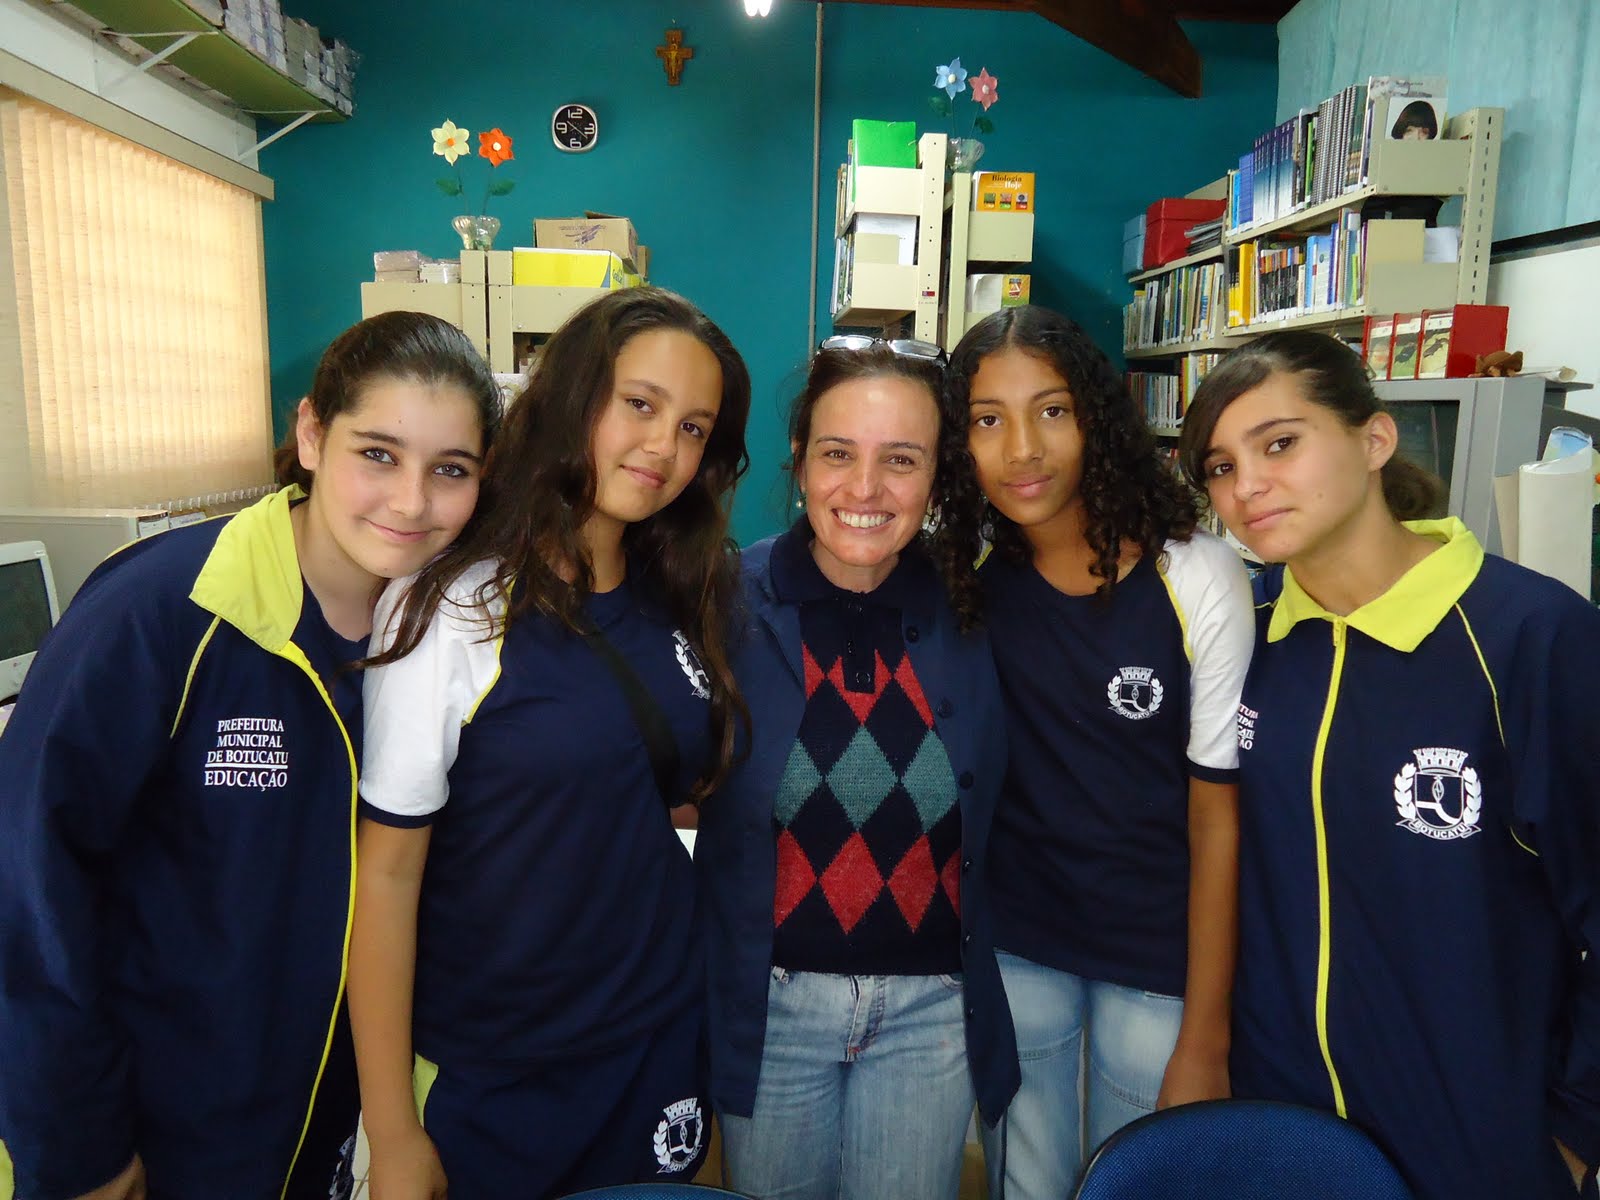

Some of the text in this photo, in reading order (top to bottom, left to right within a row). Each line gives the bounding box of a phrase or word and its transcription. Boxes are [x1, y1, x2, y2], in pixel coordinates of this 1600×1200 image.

[567, 108, 583, 119] 12
[556, 122, 568, 134] 9
[584, 123, 595, 135] 3
[569, 138, 582, 149] 6
[216, 717, 285, 733] PREFEITURA
[216, 734, 283, 748] MUNICIPAL
[206, 749, 289, 764] DE BOTUCATU
[204, 768, 288, 792] EDUCAÇÃO
[1413, 818, 1468, 839] BOTUCATU
